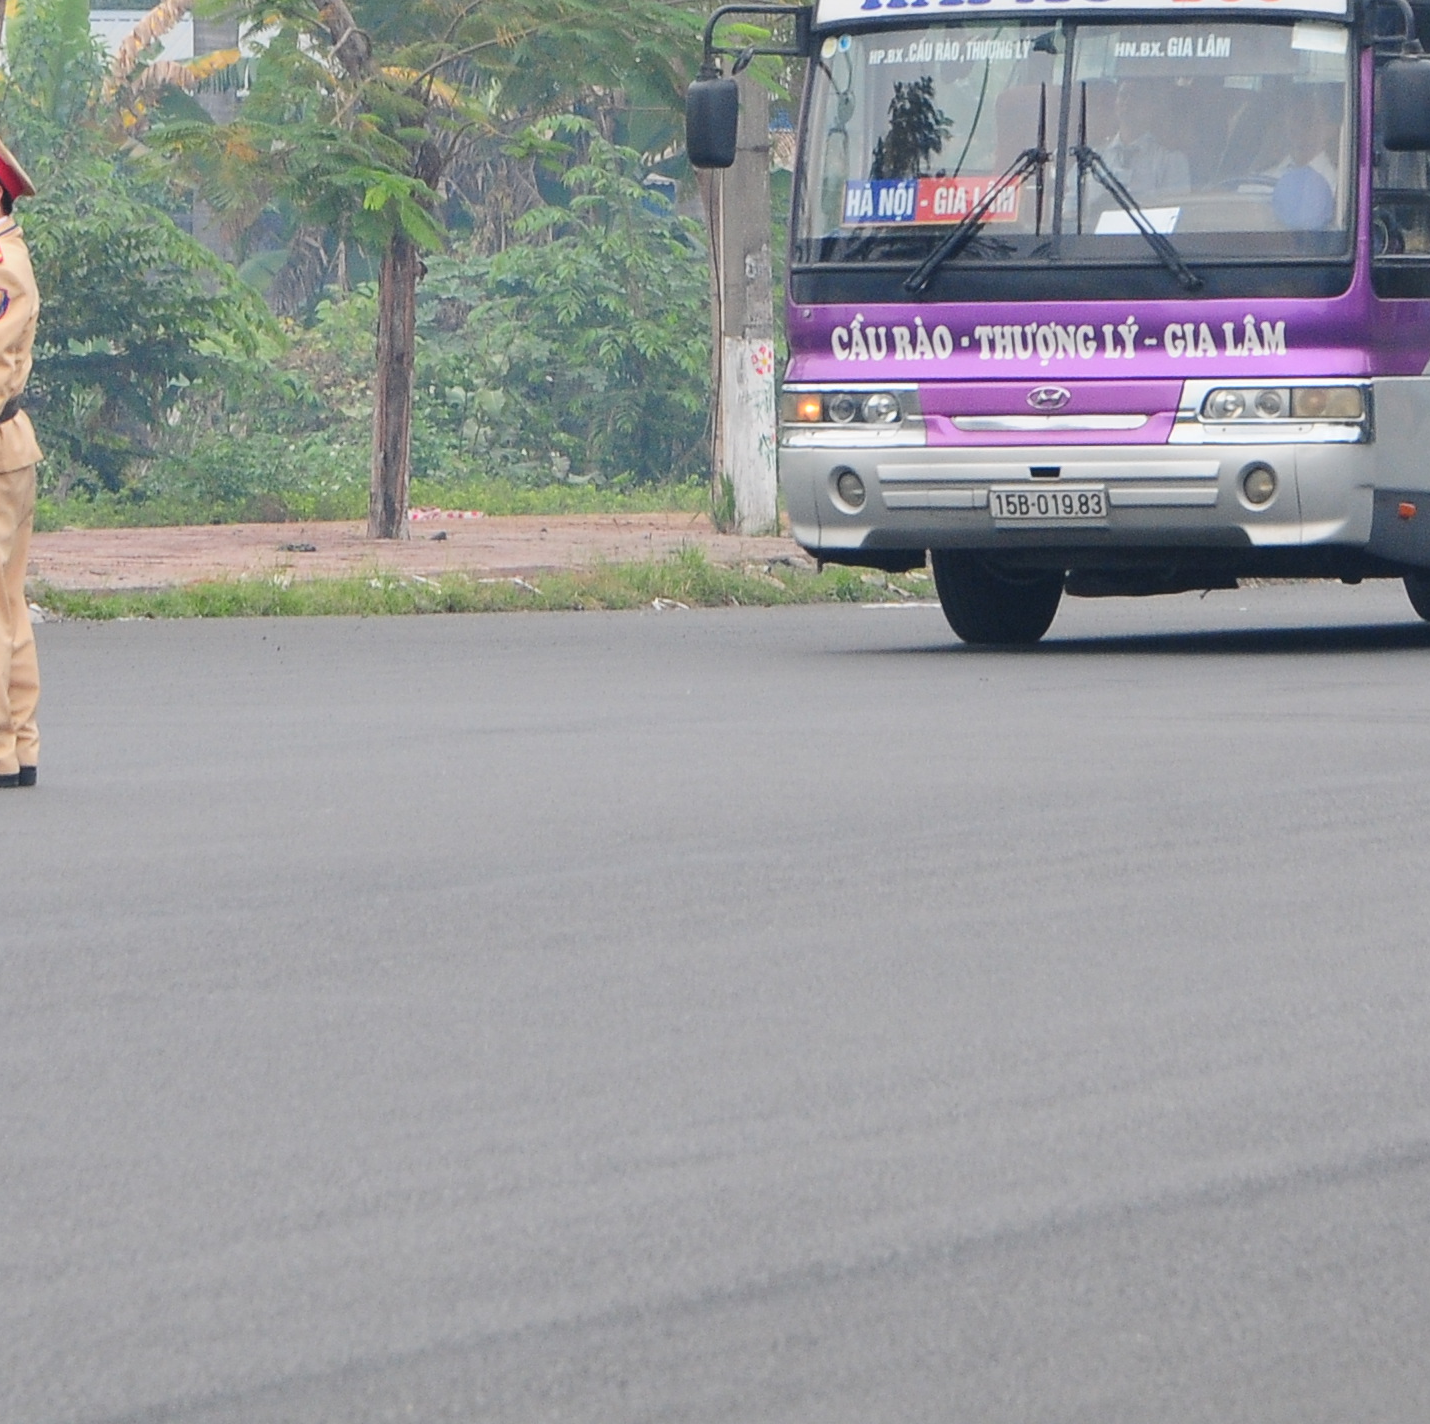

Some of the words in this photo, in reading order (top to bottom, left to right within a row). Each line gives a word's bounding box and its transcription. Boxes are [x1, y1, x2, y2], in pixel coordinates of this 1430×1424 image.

[1168, 37, 1192, 57] GIA
[1197, 33, 1231, 57] LÂM
[846, 181, 873, 217] HÀ
[878, 181, 914, 221] NỘI
[934, 186, 967, 217] GIA
[831, 313, 888, 361] CẦU
[892, 315, 954, 360] RÀO
[974, 321, 1099, 367] THƯỢNG
[1102, 315, 1139, 359] LÝ
[1164, 322, 1218, 358] GIA
[1222, 313, 1287, 357] LÂM
[996, 493, 1103, 515] 15B-019.83
